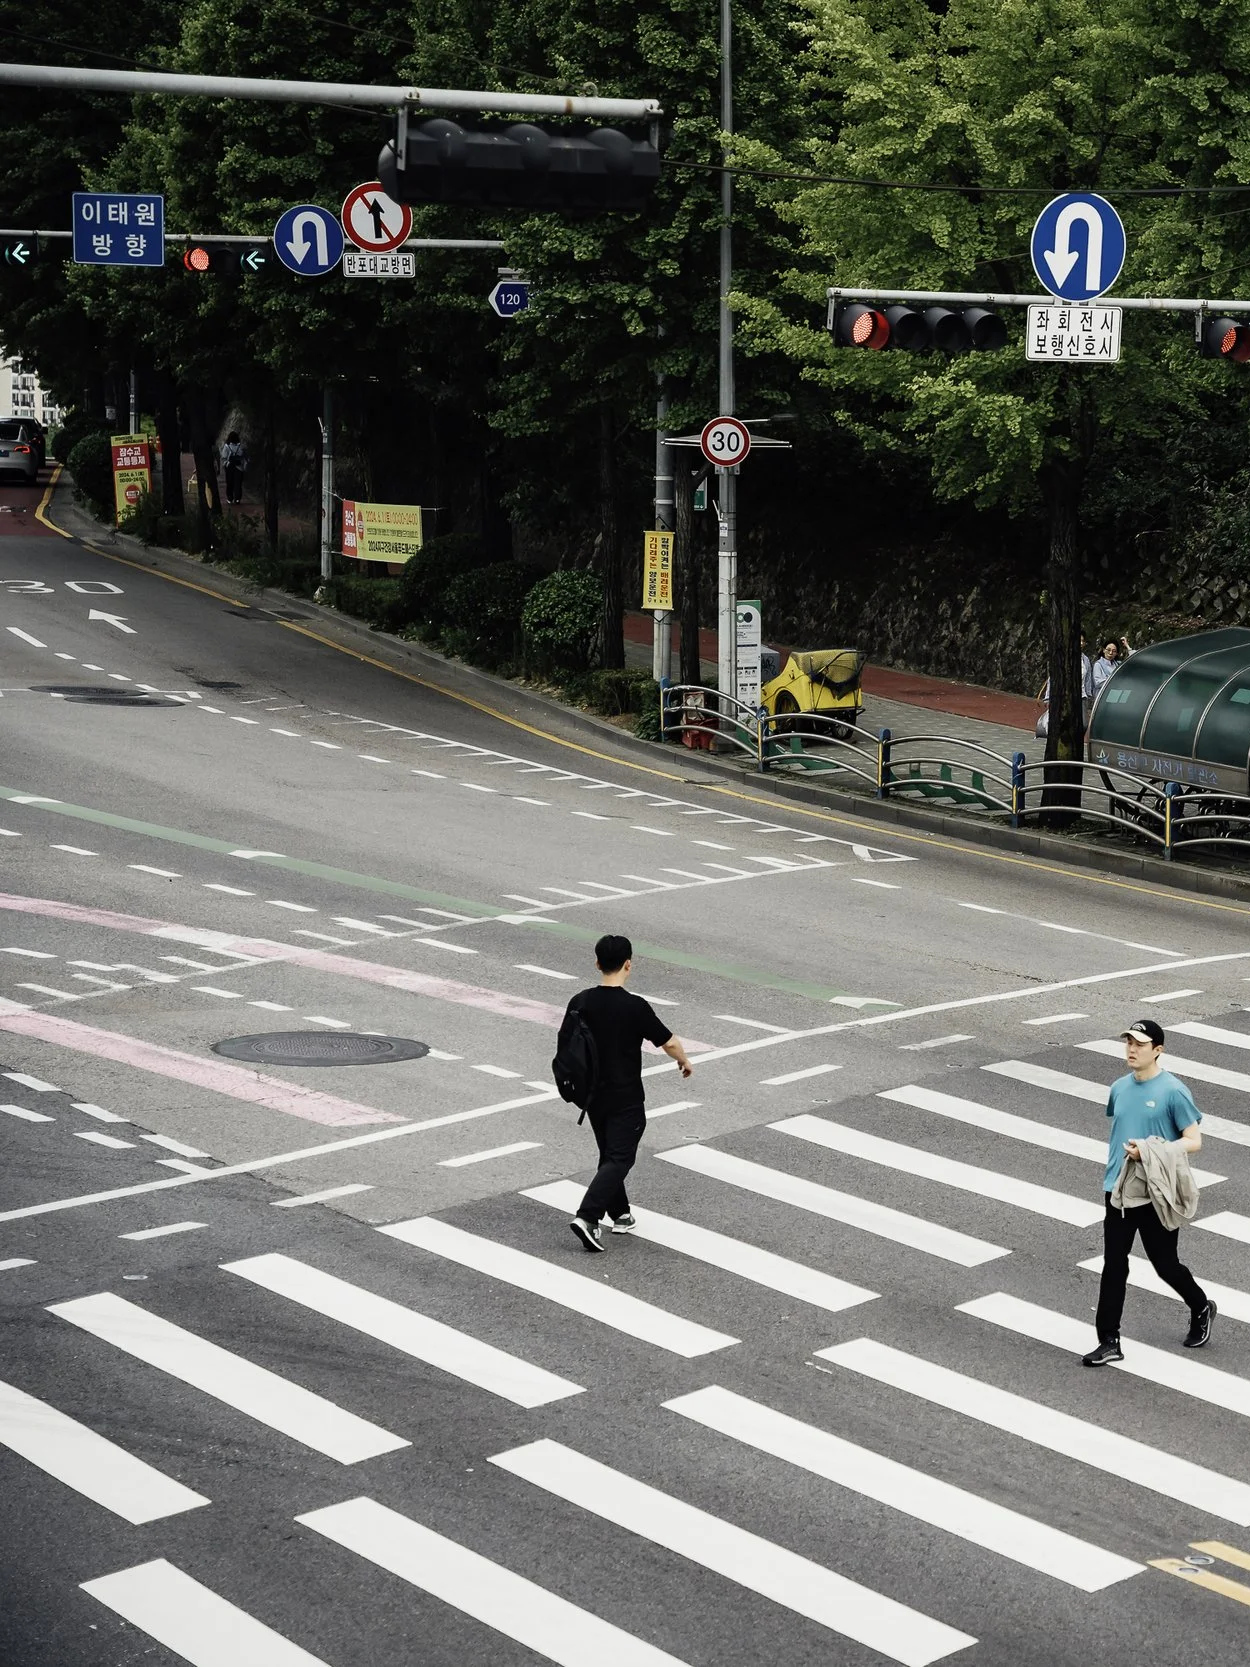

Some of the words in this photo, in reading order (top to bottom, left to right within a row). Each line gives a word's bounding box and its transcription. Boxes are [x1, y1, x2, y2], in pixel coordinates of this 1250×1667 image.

[82, 200, 155, 226] 이태원
[92, 233, 147, 258] 방향
[346, 255, 411, 275] 반포대교방면
[500, 293, 520, 305] 120
[1036, 309, 1114, 333] 좌회전시
[1034, 334, 1112, 357] 보행신호시
[712, 430, 740, 452] 30
